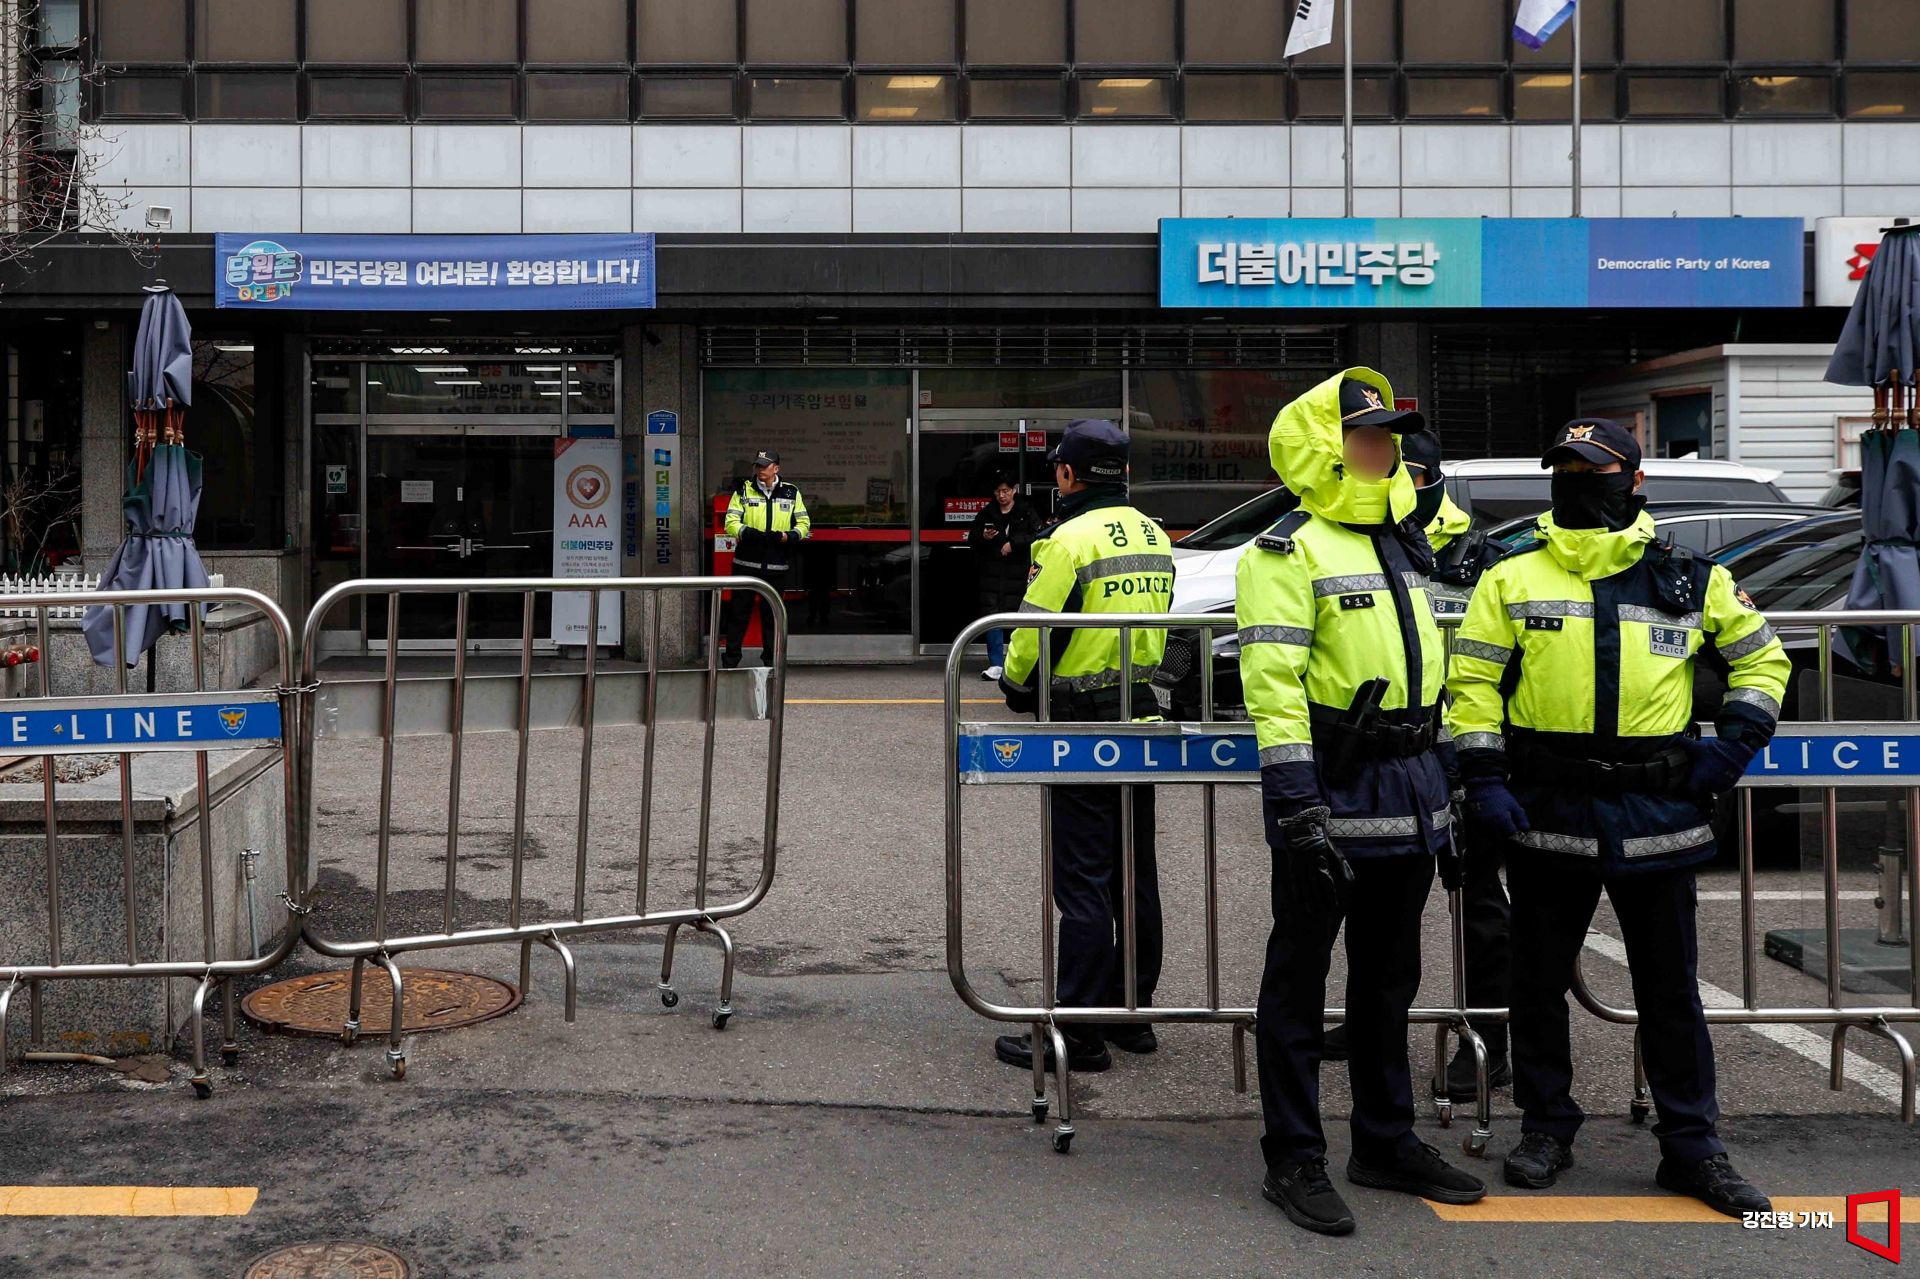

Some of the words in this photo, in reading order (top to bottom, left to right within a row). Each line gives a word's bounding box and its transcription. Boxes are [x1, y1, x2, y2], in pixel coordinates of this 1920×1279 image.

[228, 252, 298, 284] 당원존
[309, 260, 408, 286] 민주당원
[416, 260, 499, 286] 여러분!
[506, 259, 641, 285] 환영합니다!
[1197, 242, 1441, 286] 더불어민주당
[1598, 257, 1671, 270] Democratic
[1676, 258, 1710, 271] Party
[1715, 257, 1728, 269] of
[1732, 257, 1770, 270] Korea
[238, 284, 291, 301] OPEN
[658, 422, 666, 433] 7
[568, 513, 608, 528] AAA
[655, 470, 672, 565] 더불어민주당
[560, 540, 614, 551] 더불어민주당
[1104, 520, 1158, 547] 경찰
[1103, 577, 1169, 598] POLICE
[1653, 628, 1685, 646] 경찰
[1653, 644, 1685, 655] POLICE
[71, 710, 193, 740] LINE
[1053, 739, 1237, 767] POLIC
[1763, 741, 1900, 769] LICE
